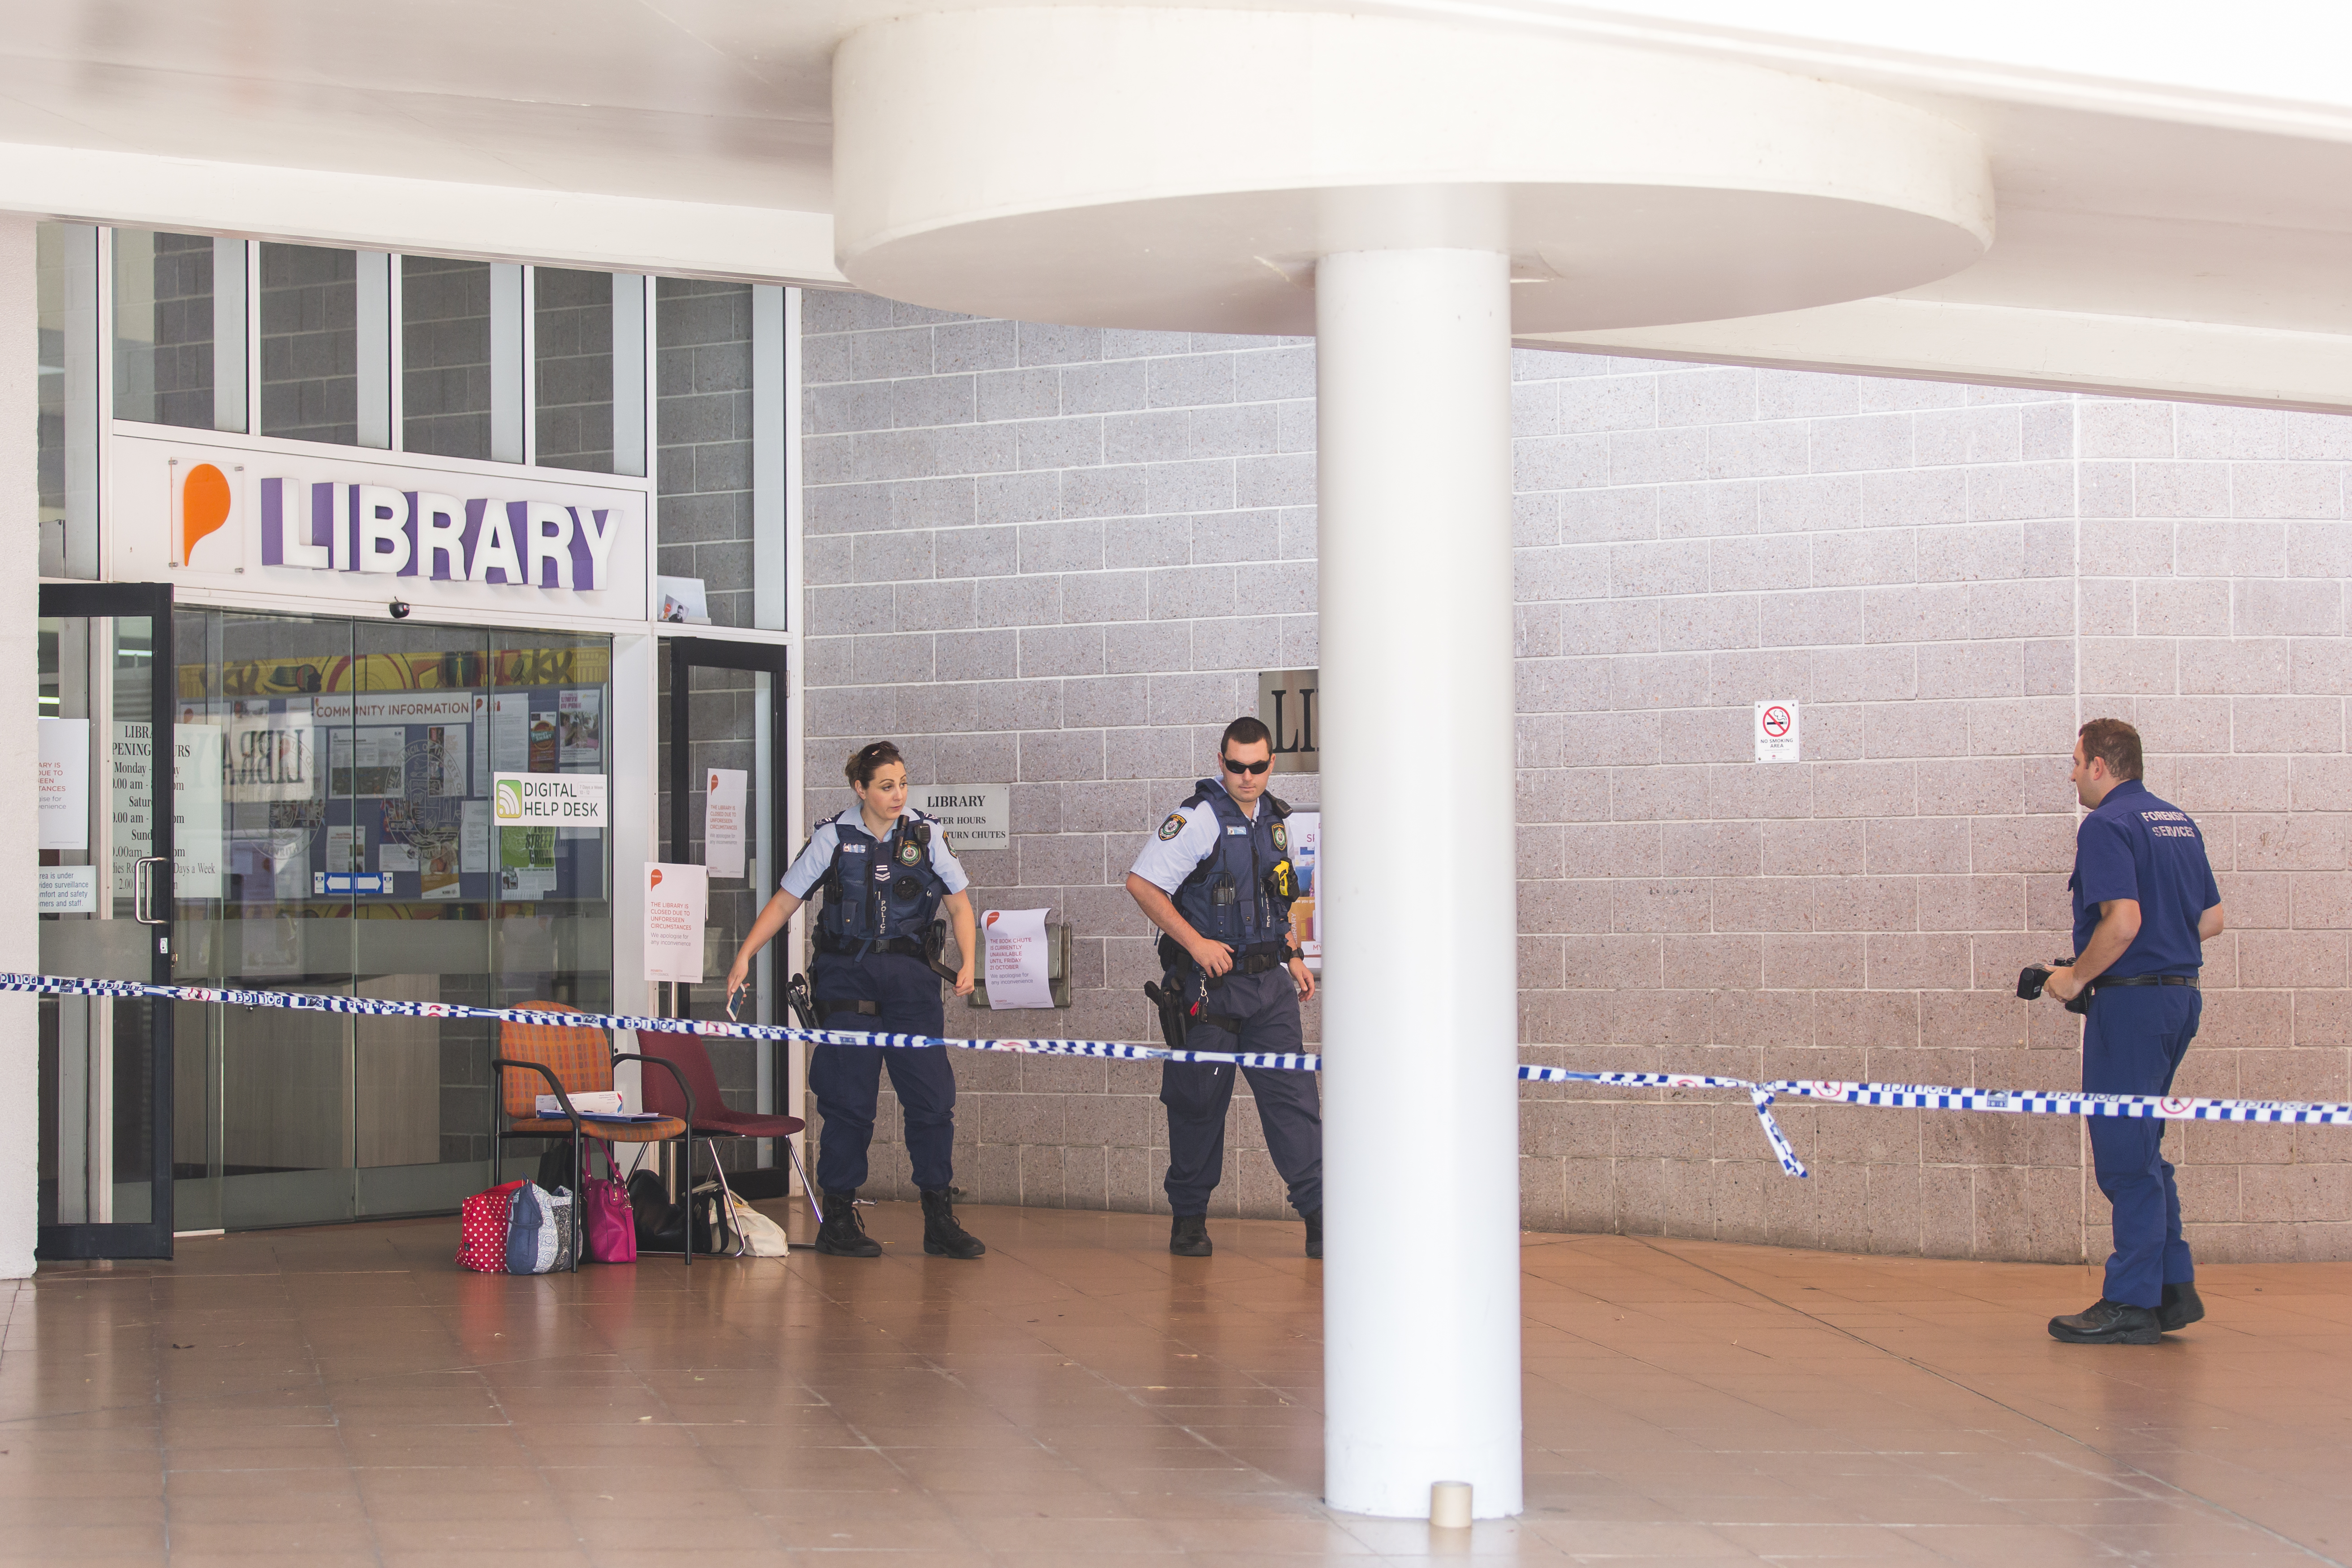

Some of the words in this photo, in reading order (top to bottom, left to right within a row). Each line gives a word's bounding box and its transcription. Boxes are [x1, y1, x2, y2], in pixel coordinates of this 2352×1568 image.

[261, 478, 624, 591] LIBRARY
[389, 702, 469, 715] INFORMATION
[1271, 688, 1318, 754] LI
[125, 725, 152, 738] LIBR
[114, 762, 146, 776] Monday
[130, 781, 143, 789] am
[525, 782, 577, 797] DIGITAL
[129, 796, 152, 807] Satur
[927, 795, 986, 807] LIBRARY
[525, 801, 558, 816] HELP
[564, 802, 598, 817] DESK
[130, 814, 143, 823] am
[957, 816, 986, 824] HOURS
[2141, 811, 2187, 822] FORENSIC
[972, 831, 1006, 839] CHUTES
[198, 863, 215, 874] Week
[119, 879, 133, 890] 2.00
[70, 891, 88, 899] safety
